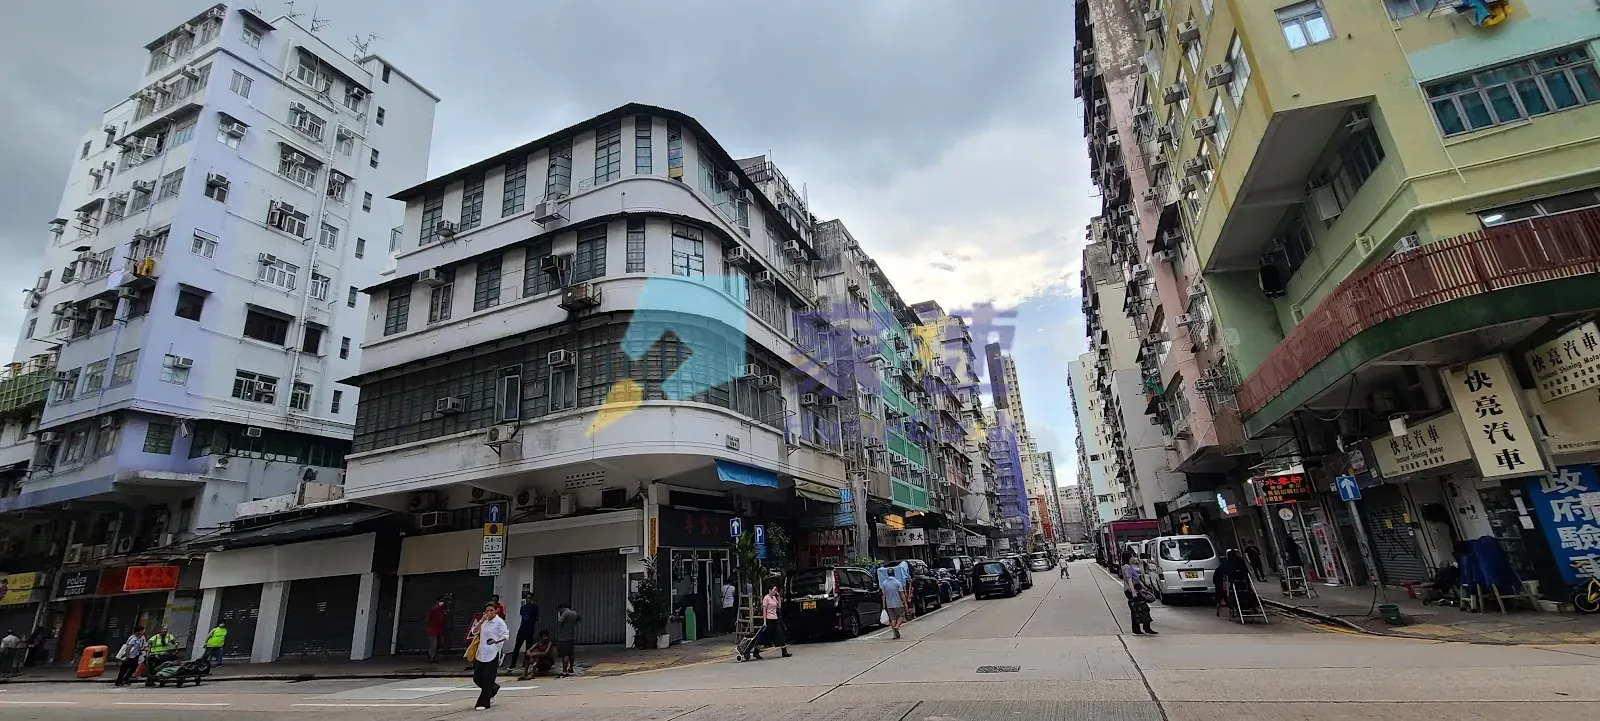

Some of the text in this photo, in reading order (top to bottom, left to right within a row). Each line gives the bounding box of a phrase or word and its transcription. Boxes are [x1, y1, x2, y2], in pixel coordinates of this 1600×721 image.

[1531, 332, 1598, 373] 快亮汽車
[1559, 361, 1582, 374] Shining
[1583, 353, 1600, 364] Moto
[1464, 369, 1525, 470] 快亮汽車
[1389, 424, 1440, 456] 快亮汽車
[1411, 450, 1429, 460] Shining
[1428, 446, 1444, 455] Motor
[1540, 468, 1600, 580] 政府驗車
[756, 527, 763, 543] P
[66, 574, 88, 585] POWER
[64, 587, 85, 596] BURGER
